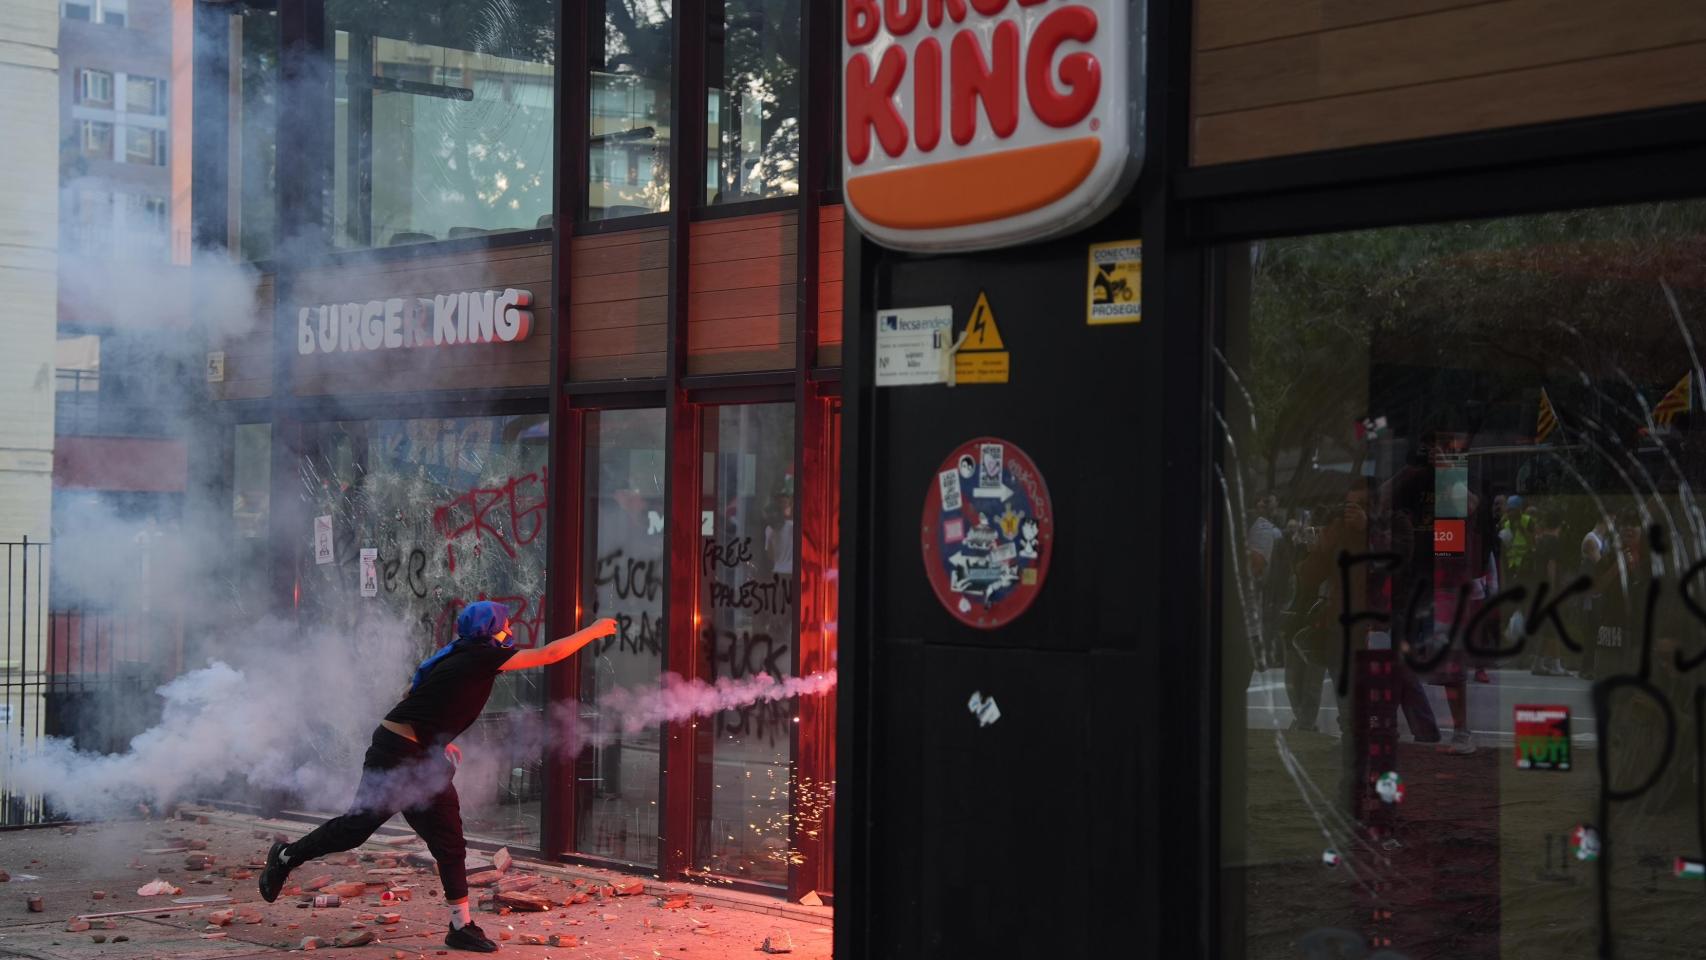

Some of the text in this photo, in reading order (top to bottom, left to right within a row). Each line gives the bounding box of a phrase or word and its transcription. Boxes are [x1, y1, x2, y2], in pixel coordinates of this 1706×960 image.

[846, 5, 1101, 165] KING
[297, 287, 527, 355] BURGER KING
[703, 537, 752, 576] FREE
